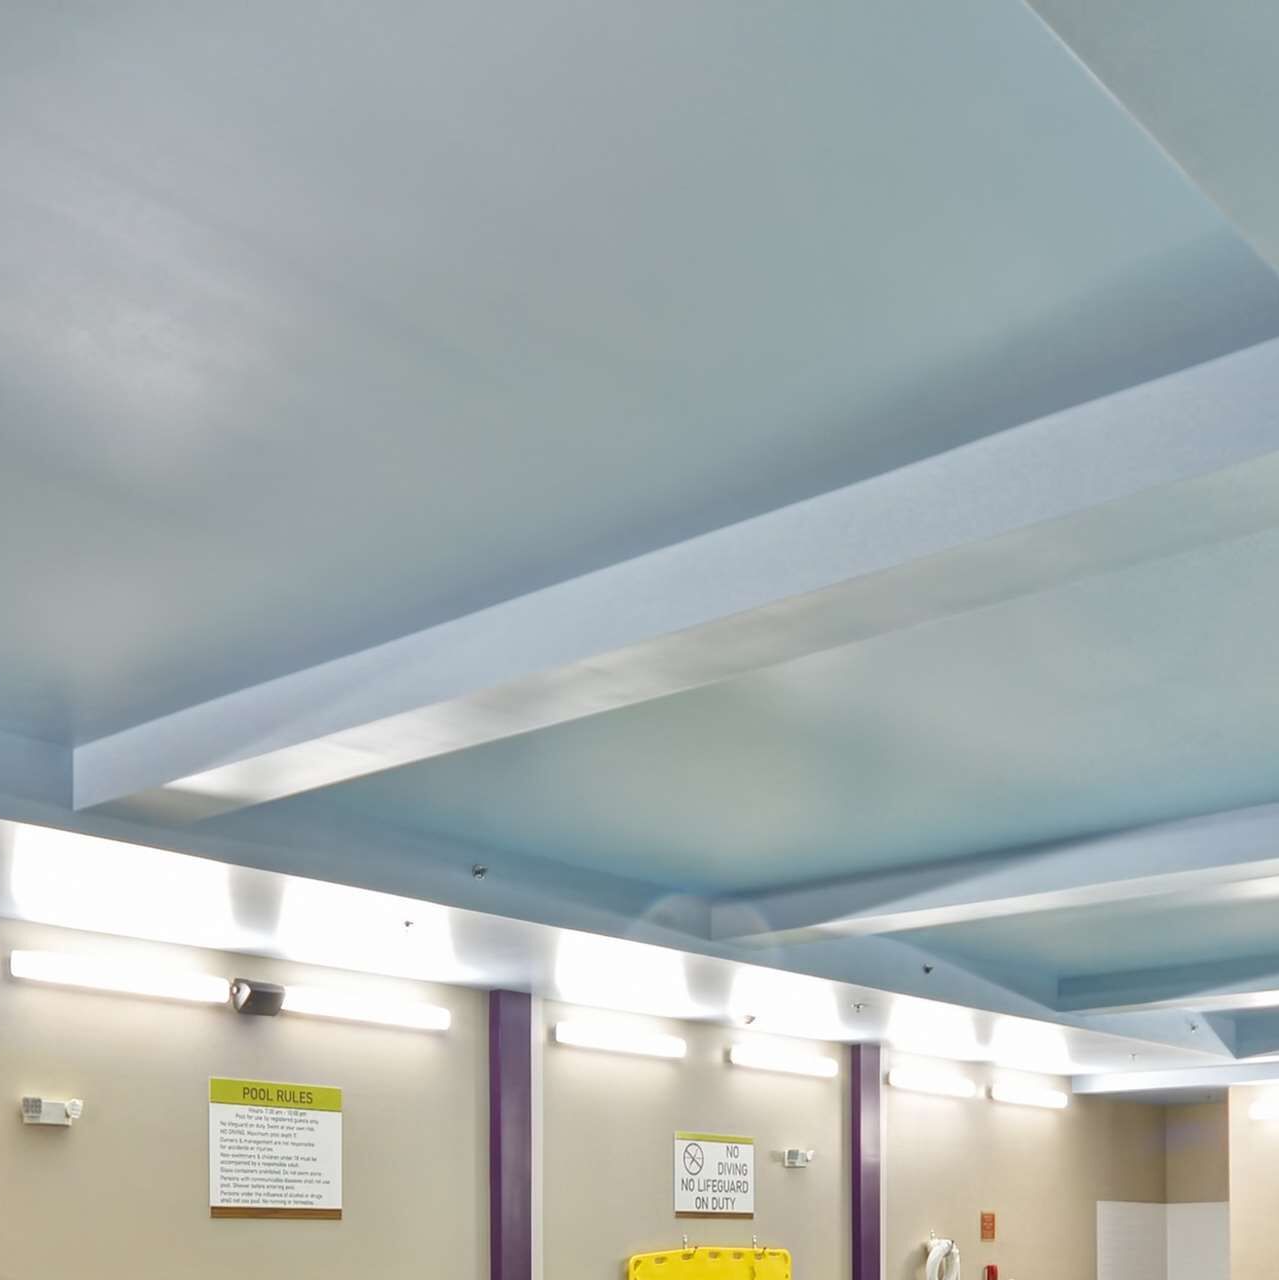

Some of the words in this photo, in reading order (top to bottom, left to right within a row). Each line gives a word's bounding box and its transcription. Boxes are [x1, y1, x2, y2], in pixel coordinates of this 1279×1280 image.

[242, 1086, 273, 1102] POOL
[276, 1089, 313, 1105] RULES
[726, 1146, 740, 1159] NO
[717, 1162, 749, 1177] DIVING
[681, 1179, 696, 1192] NO
[698, 1180, 749, 1194] LIFEGUARD
[695, 1197, 710, 1210] ON
[711, 1197, 736, 1211] DUTY
